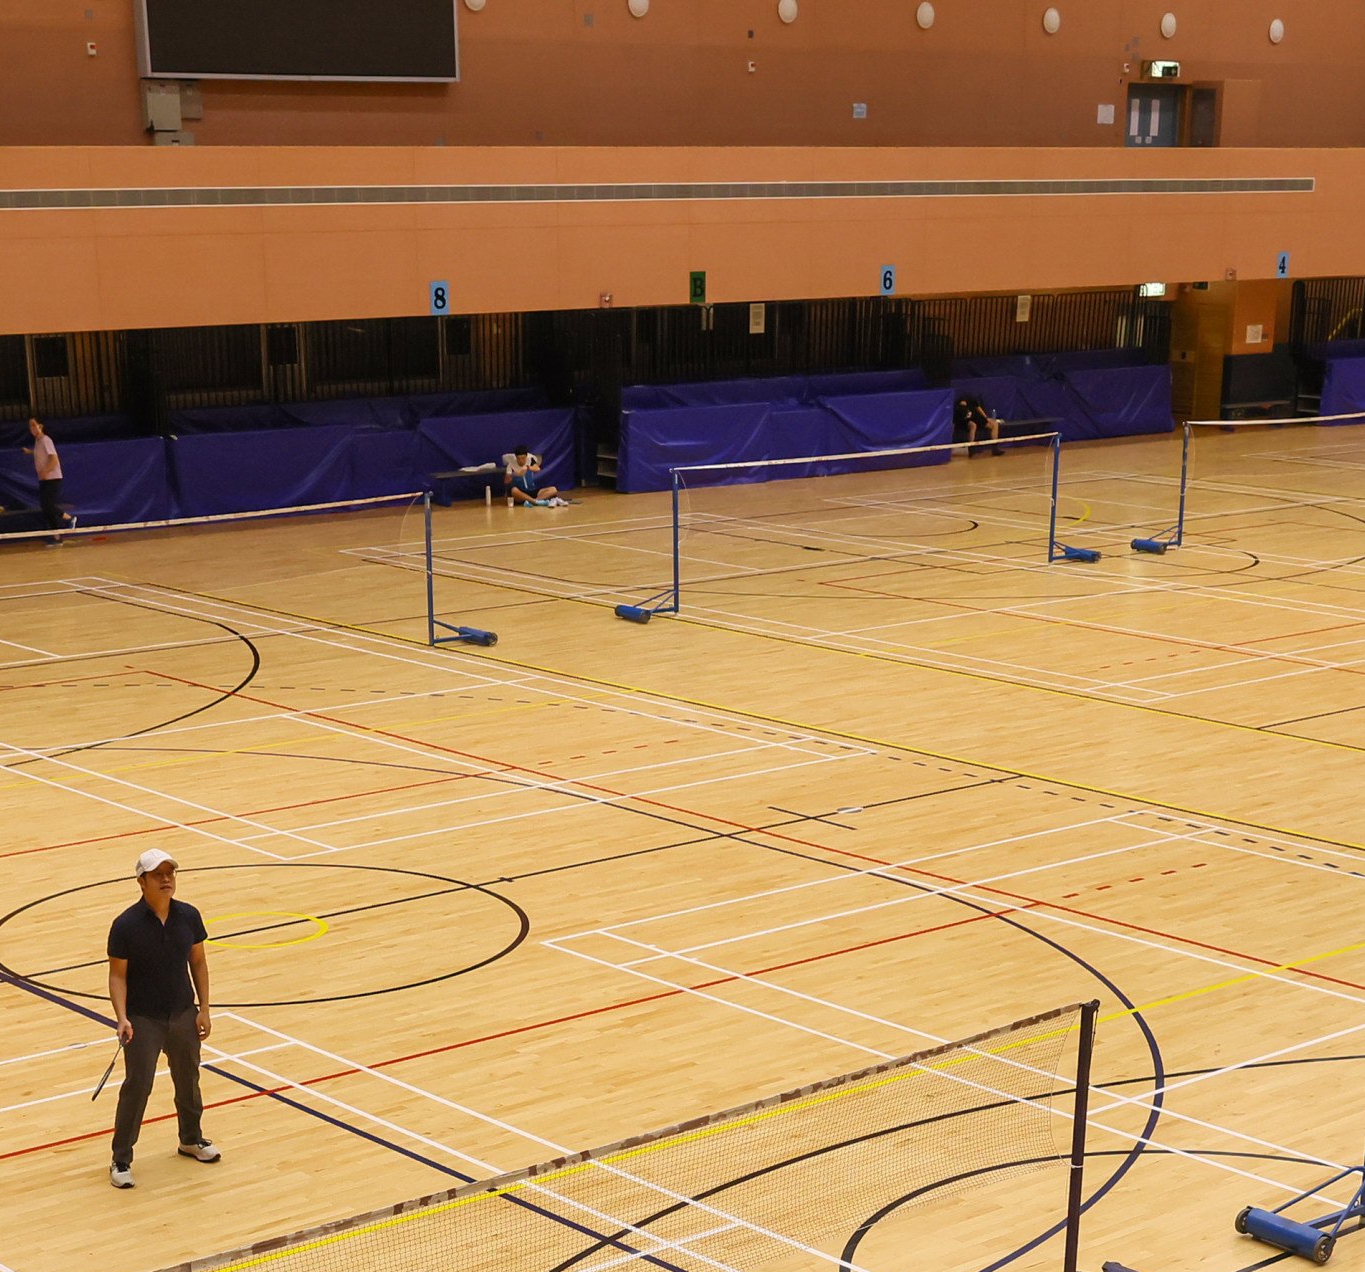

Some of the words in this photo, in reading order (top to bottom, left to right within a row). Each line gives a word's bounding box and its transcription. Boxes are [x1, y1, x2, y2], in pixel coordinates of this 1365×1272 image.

[1278, 255, 1286, 273] 4
[883, 270, 893, 290] 6
[434, 287, 446, 309] 8
